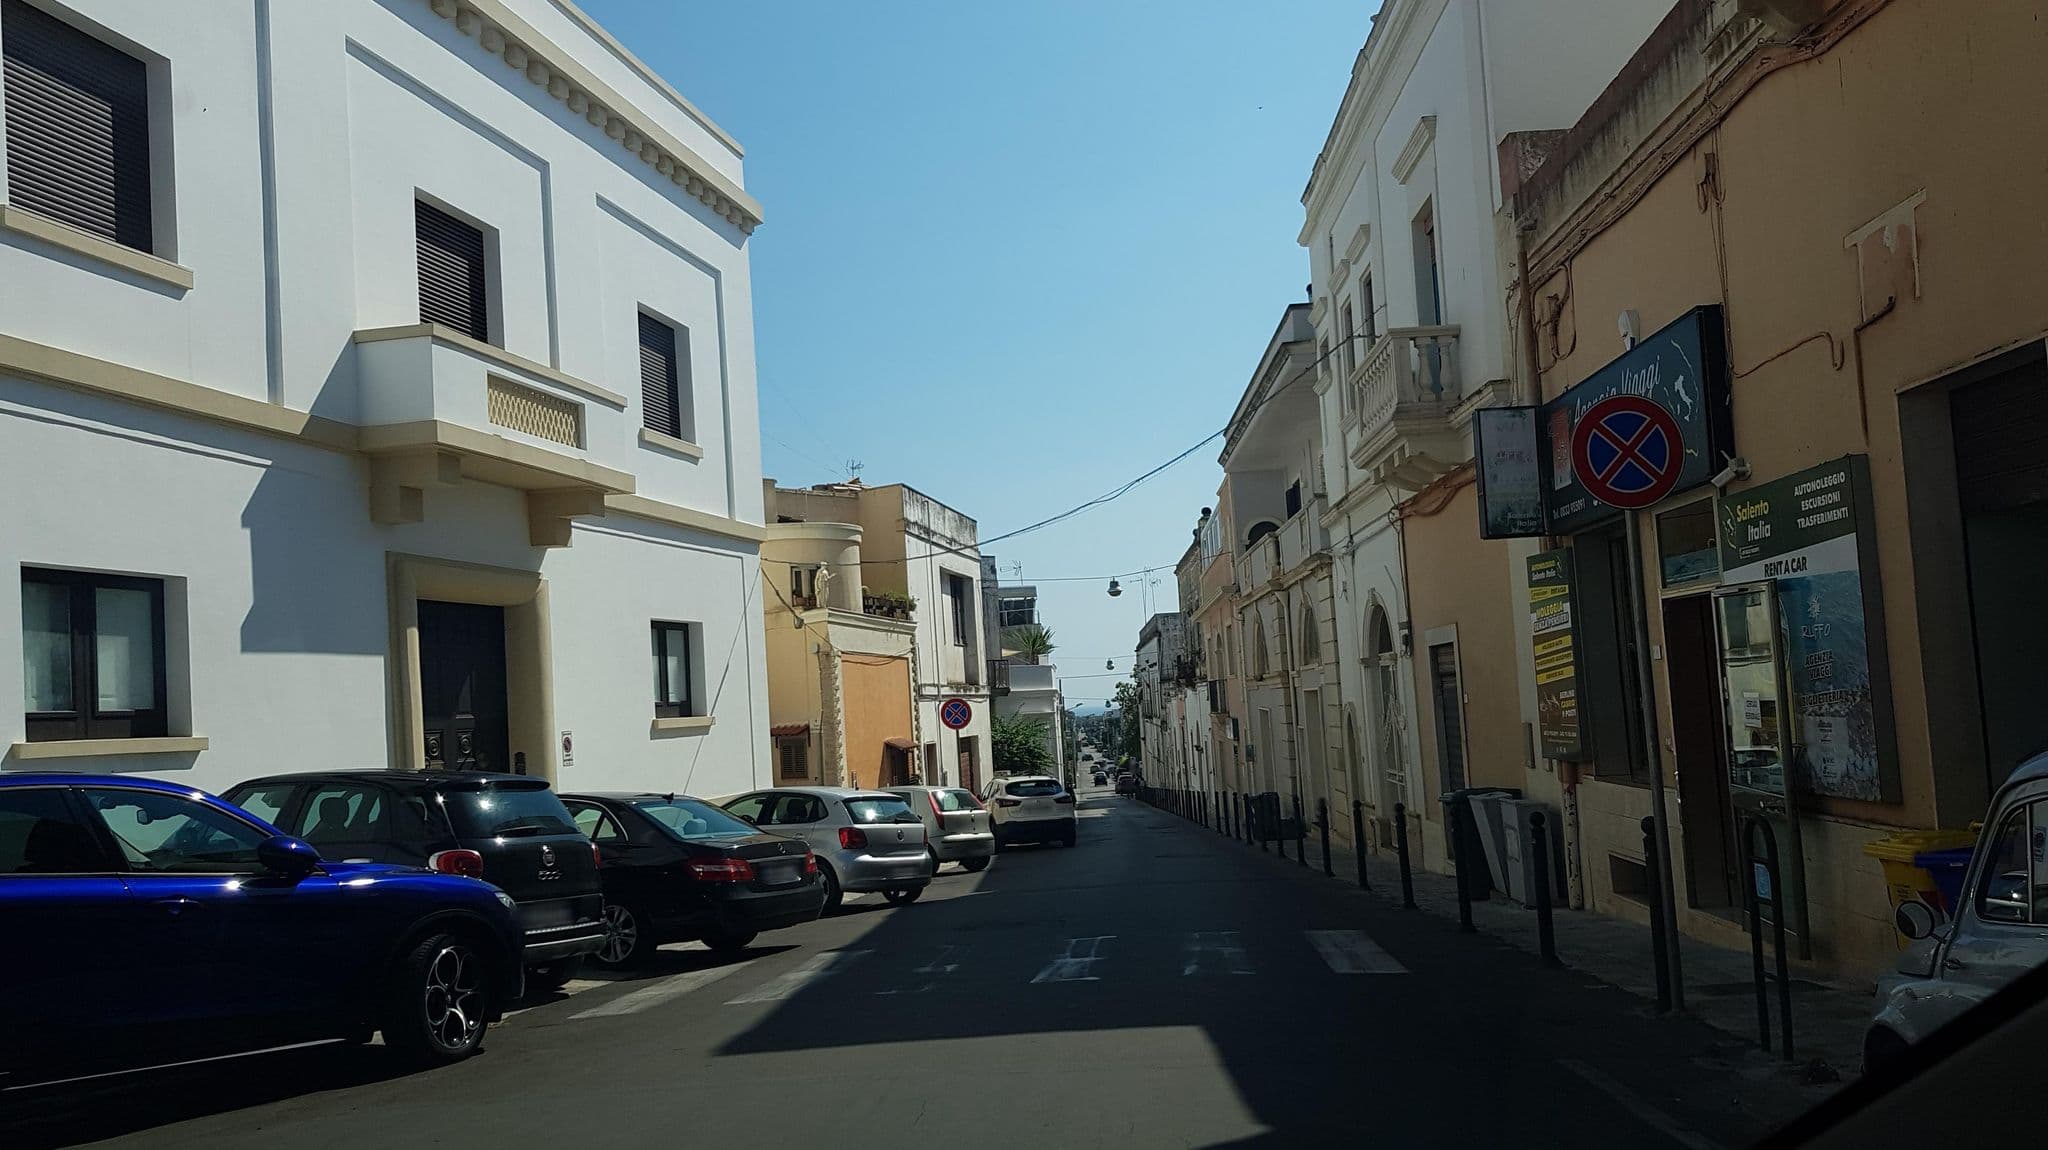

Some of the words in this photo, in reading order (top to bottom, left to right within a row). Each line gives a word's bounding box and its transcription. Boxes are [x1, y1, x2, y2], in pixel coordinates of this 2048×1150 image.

[1794, 471, 1846, 497] AUTONOLEGGIO
[1736, 499, 1769, 523] Salento
[1801, 491, 1841, 511] ESCURSIONI
[1797, 506, 1849, 529] TRASFERIMENTI
[1747, 519, 1771, 542] Italia
[1764, 561, 1784, 578] RENT
[1784, 560, 1790, 575] A
[1790, 556, 1808, 574] CAR
[1804, 649, 1834, 667] AGENZIA
[1809, 663, 1833, 680] VIAGGI
